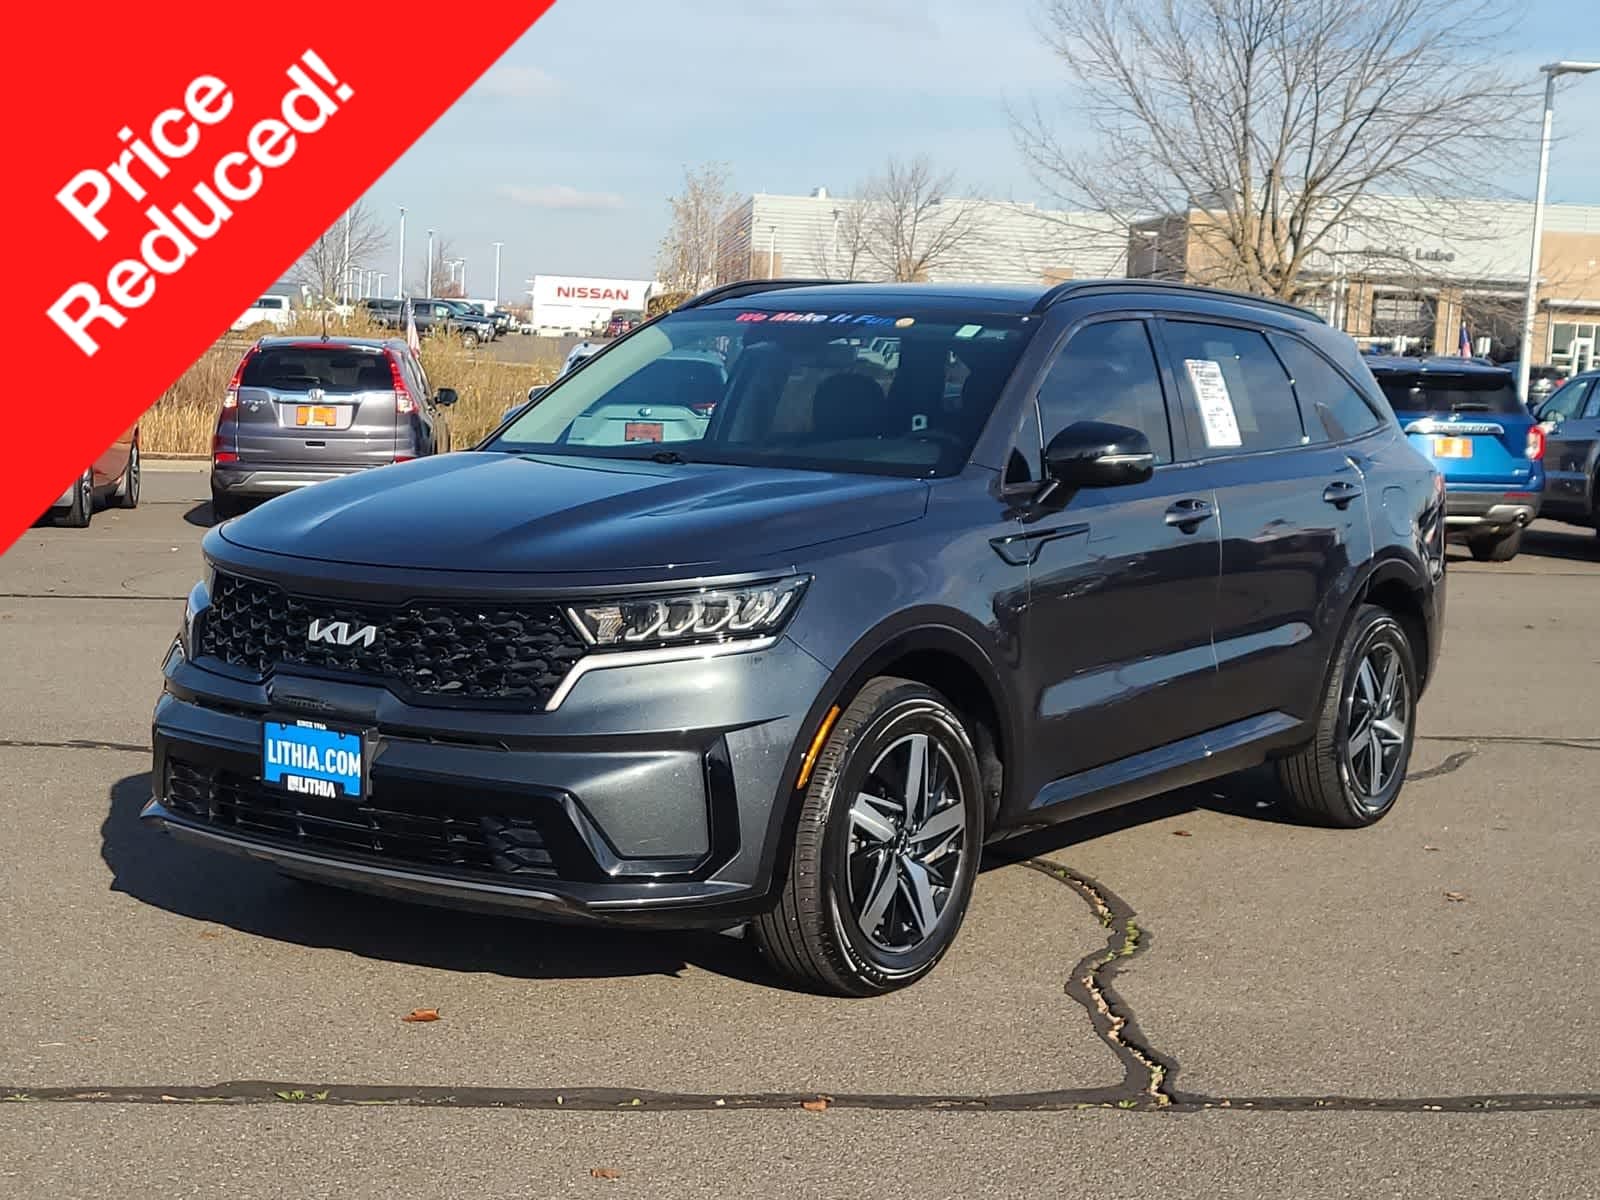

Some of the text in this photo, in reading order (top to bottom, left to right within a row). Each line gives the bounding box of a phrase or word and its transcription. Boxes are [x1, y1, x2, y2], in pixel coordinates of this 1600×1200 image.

[556, 285, 629, 300] NISSAN
[769, 312, 828, 323] Make
[308, 618, 377, 648] KIA
[267, 738, 361, 778] LITHIA.COM
[299, 776, 336, 799] LITHIA
